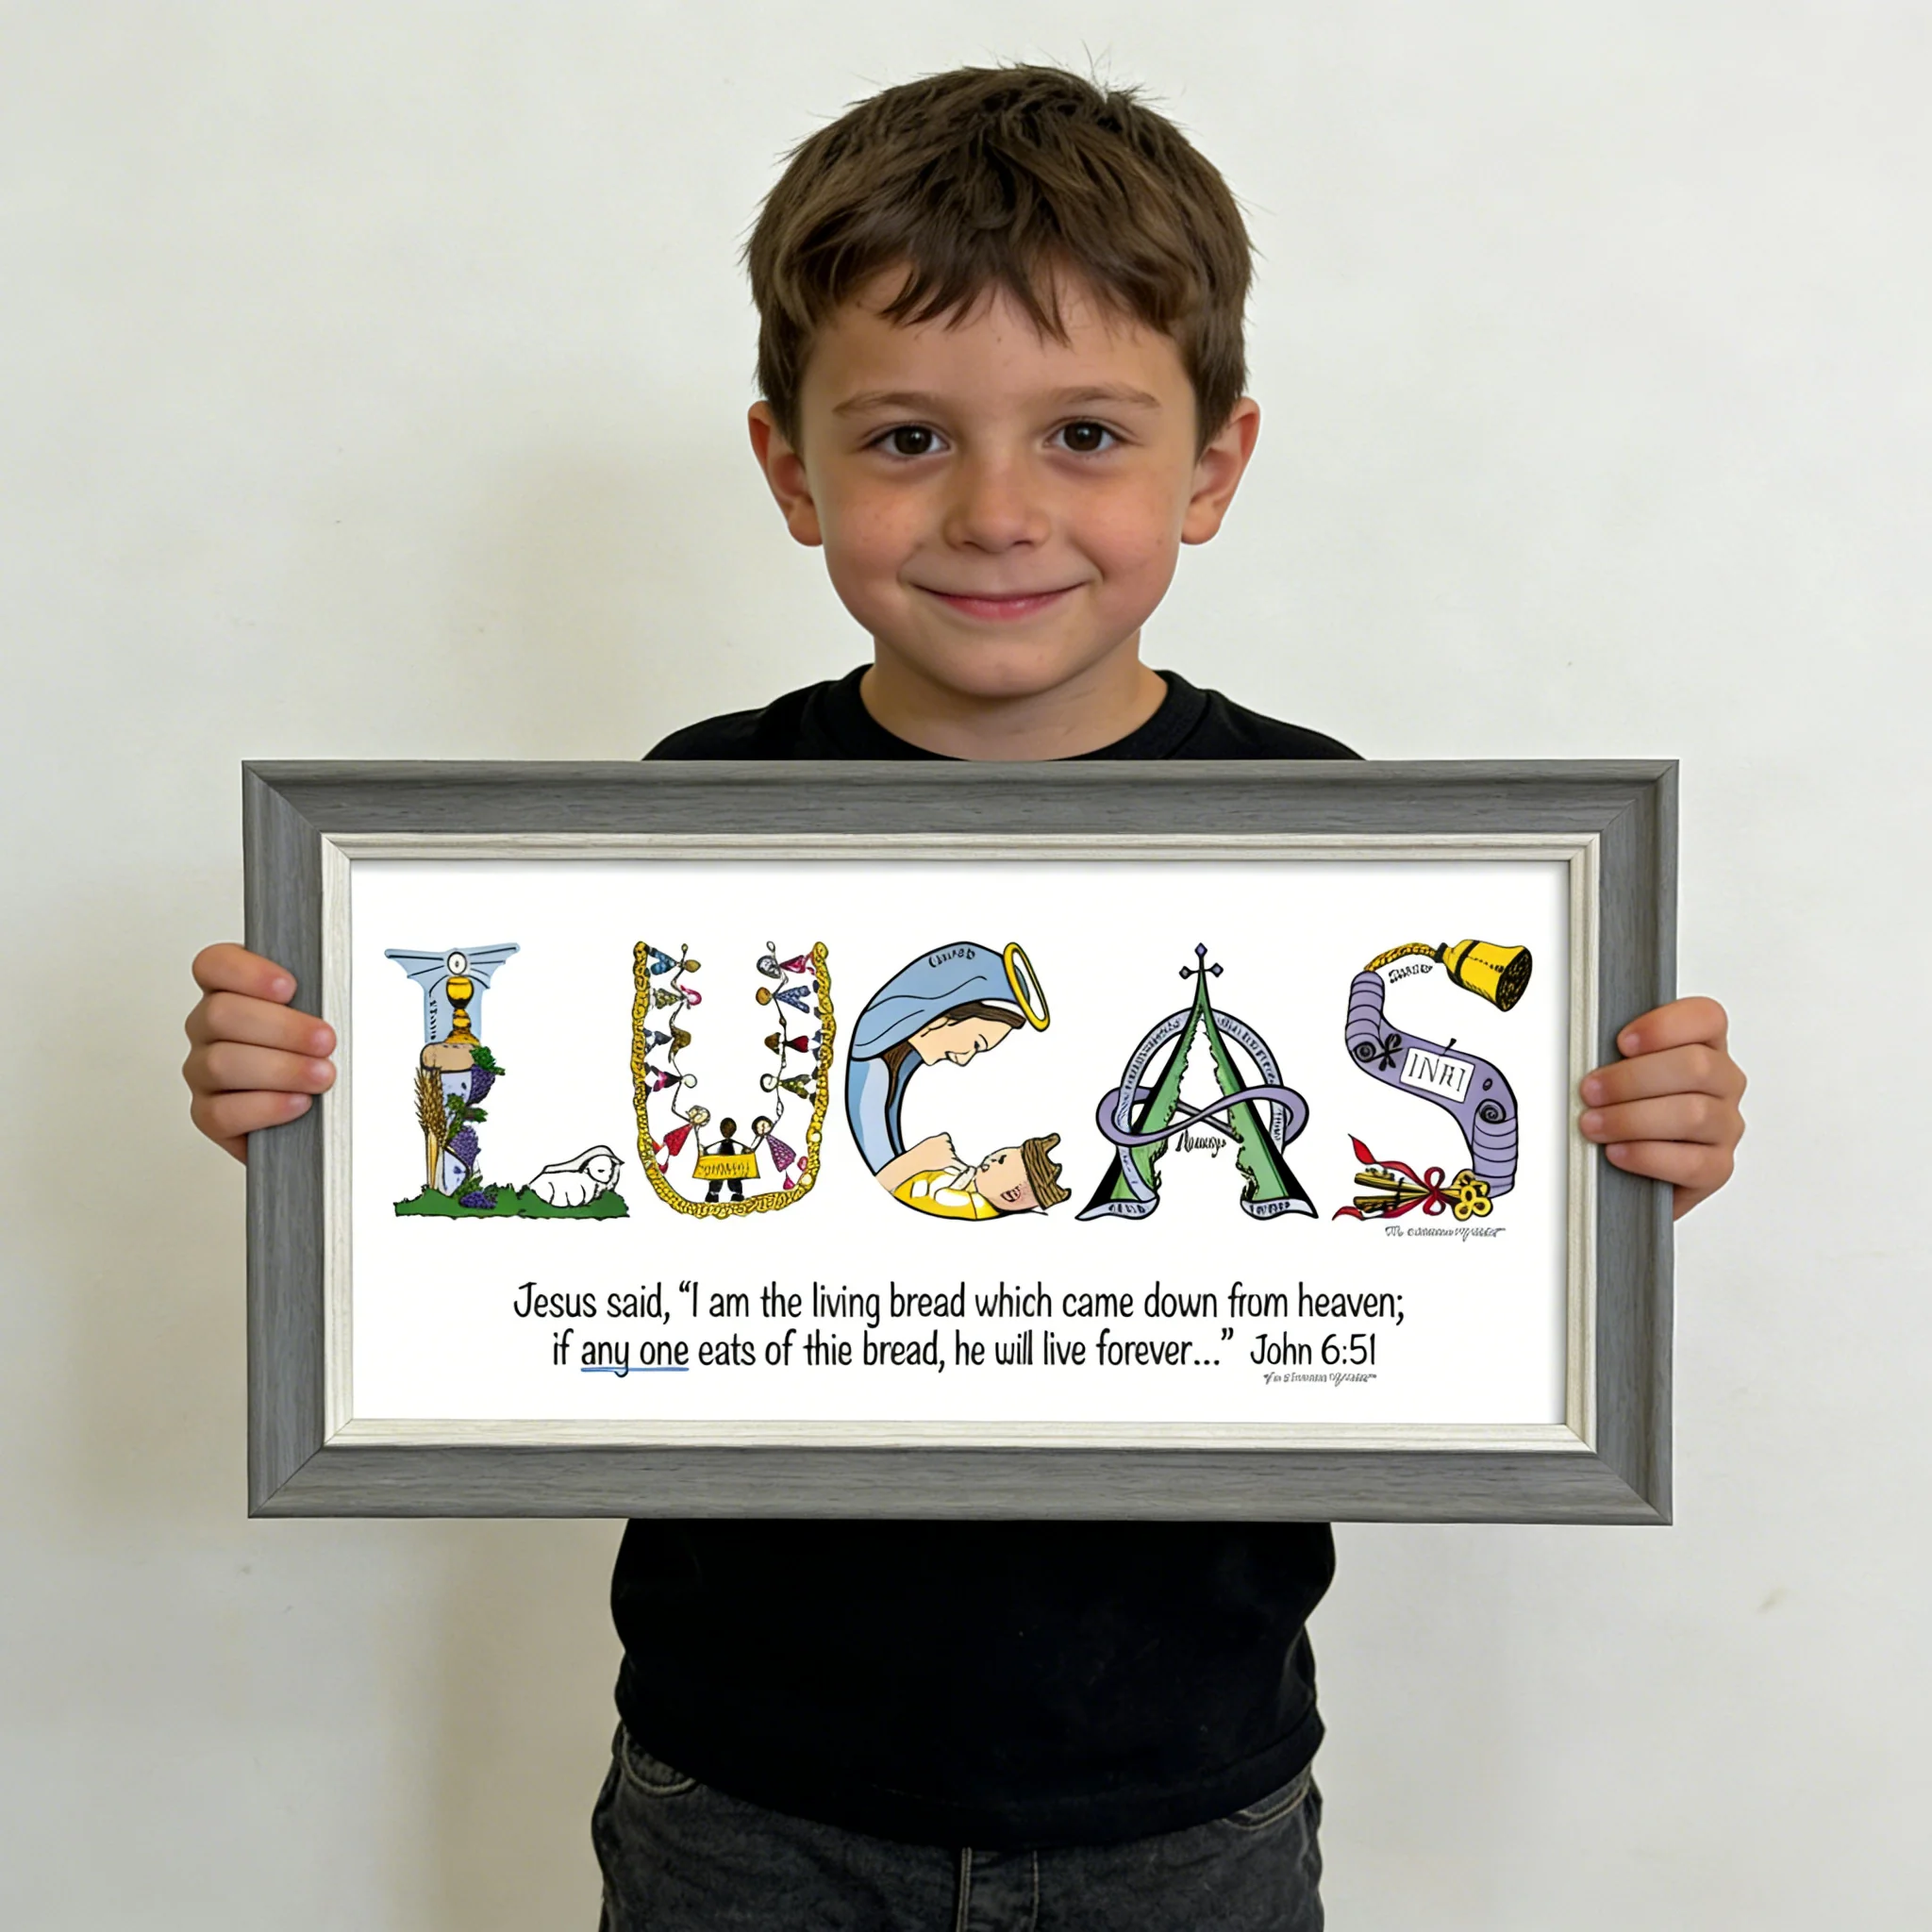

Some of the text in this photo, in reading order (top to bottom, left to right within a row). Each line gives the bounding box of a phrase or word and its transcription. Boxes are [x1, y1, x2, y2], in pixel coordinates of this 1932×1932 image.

[385, 941, 1534, 1223] LUCAS
[1407, 1053, 1466, 1092] INRI
[513, 1279, 1405, 1329] Jesus said, “I am the living bread which came down from heaven;
[553, 1327, 575, 1366] if
[580, 1341, 630, 1378] any
[640, 1341, 690, 1366] one
[698, 1333, 757, 1366] eats
[764, 1327, 797, 1366] of
[802, 1328, 853, 1366] thie
[863, 1329, 945, 1374] bread,
[955, 1328, 986, 1366] he
[994, 1328, 1034, 1366] will
[1043, 1329, 1086, 1366] live
[1250, 1330, 1312, 1366] John
[1321, 1333, 1375, 1366] 6:51
